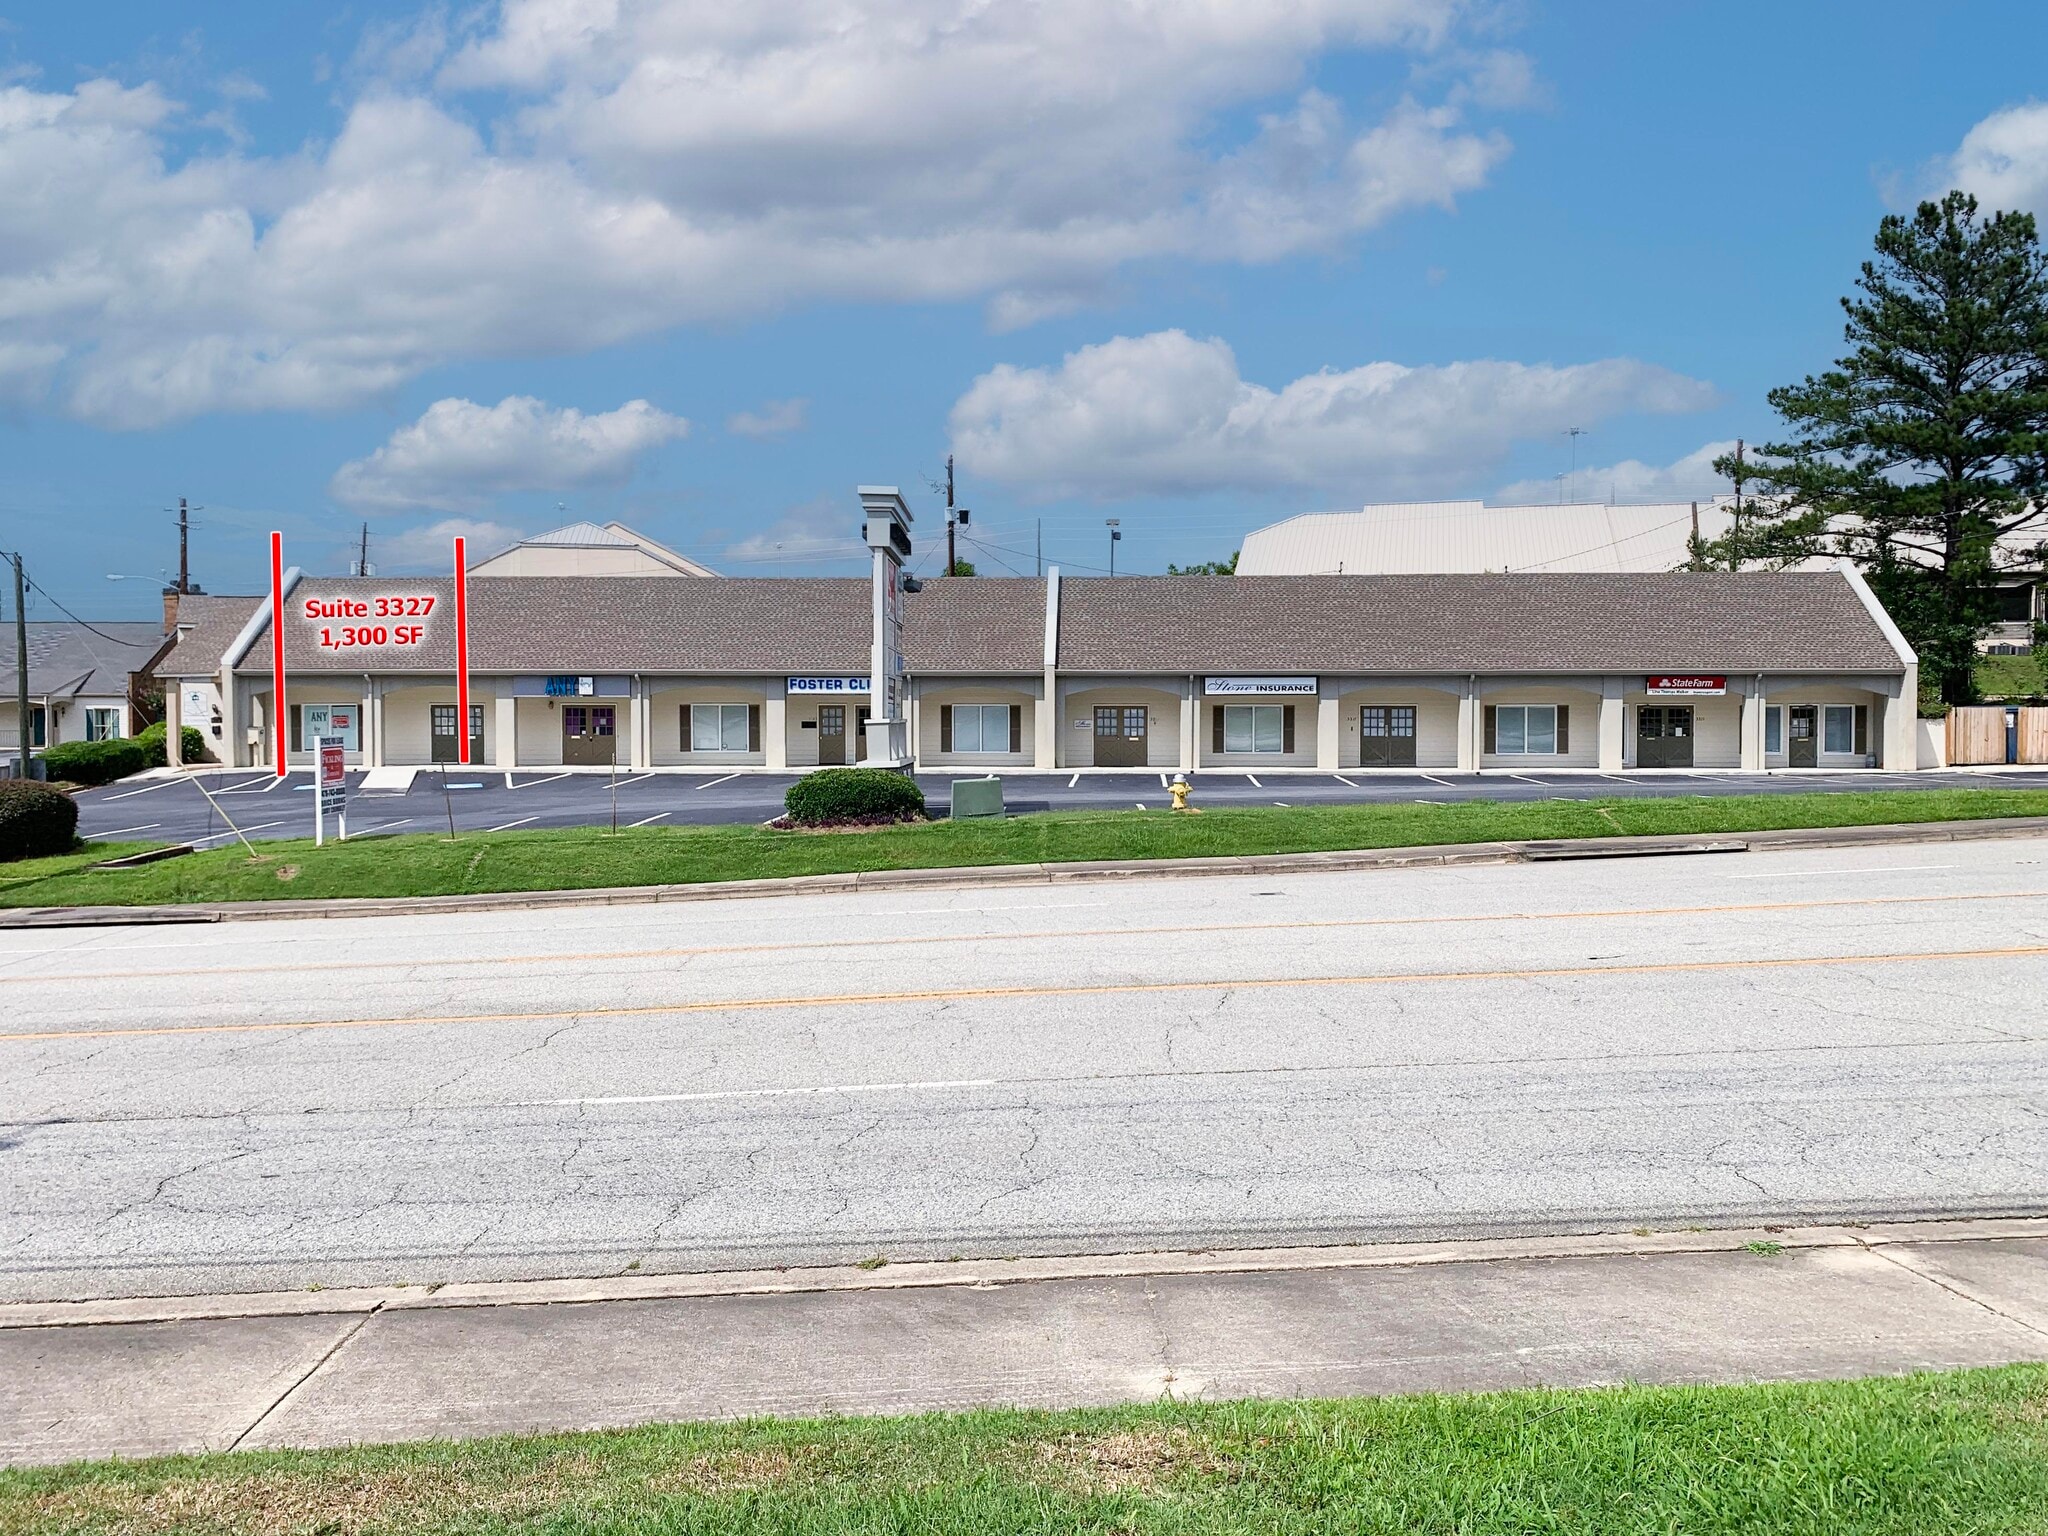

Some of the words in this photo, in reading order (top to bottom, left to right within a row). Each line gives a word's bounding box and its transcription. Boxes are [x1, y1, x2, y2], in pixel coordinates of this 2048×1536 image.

[545, 677, 577, 696] ANY
[789, 679, 842, 690] FOSTER
[1207, 678, 1252, 692] Stone
[311, 711, 328, 721] ANY
